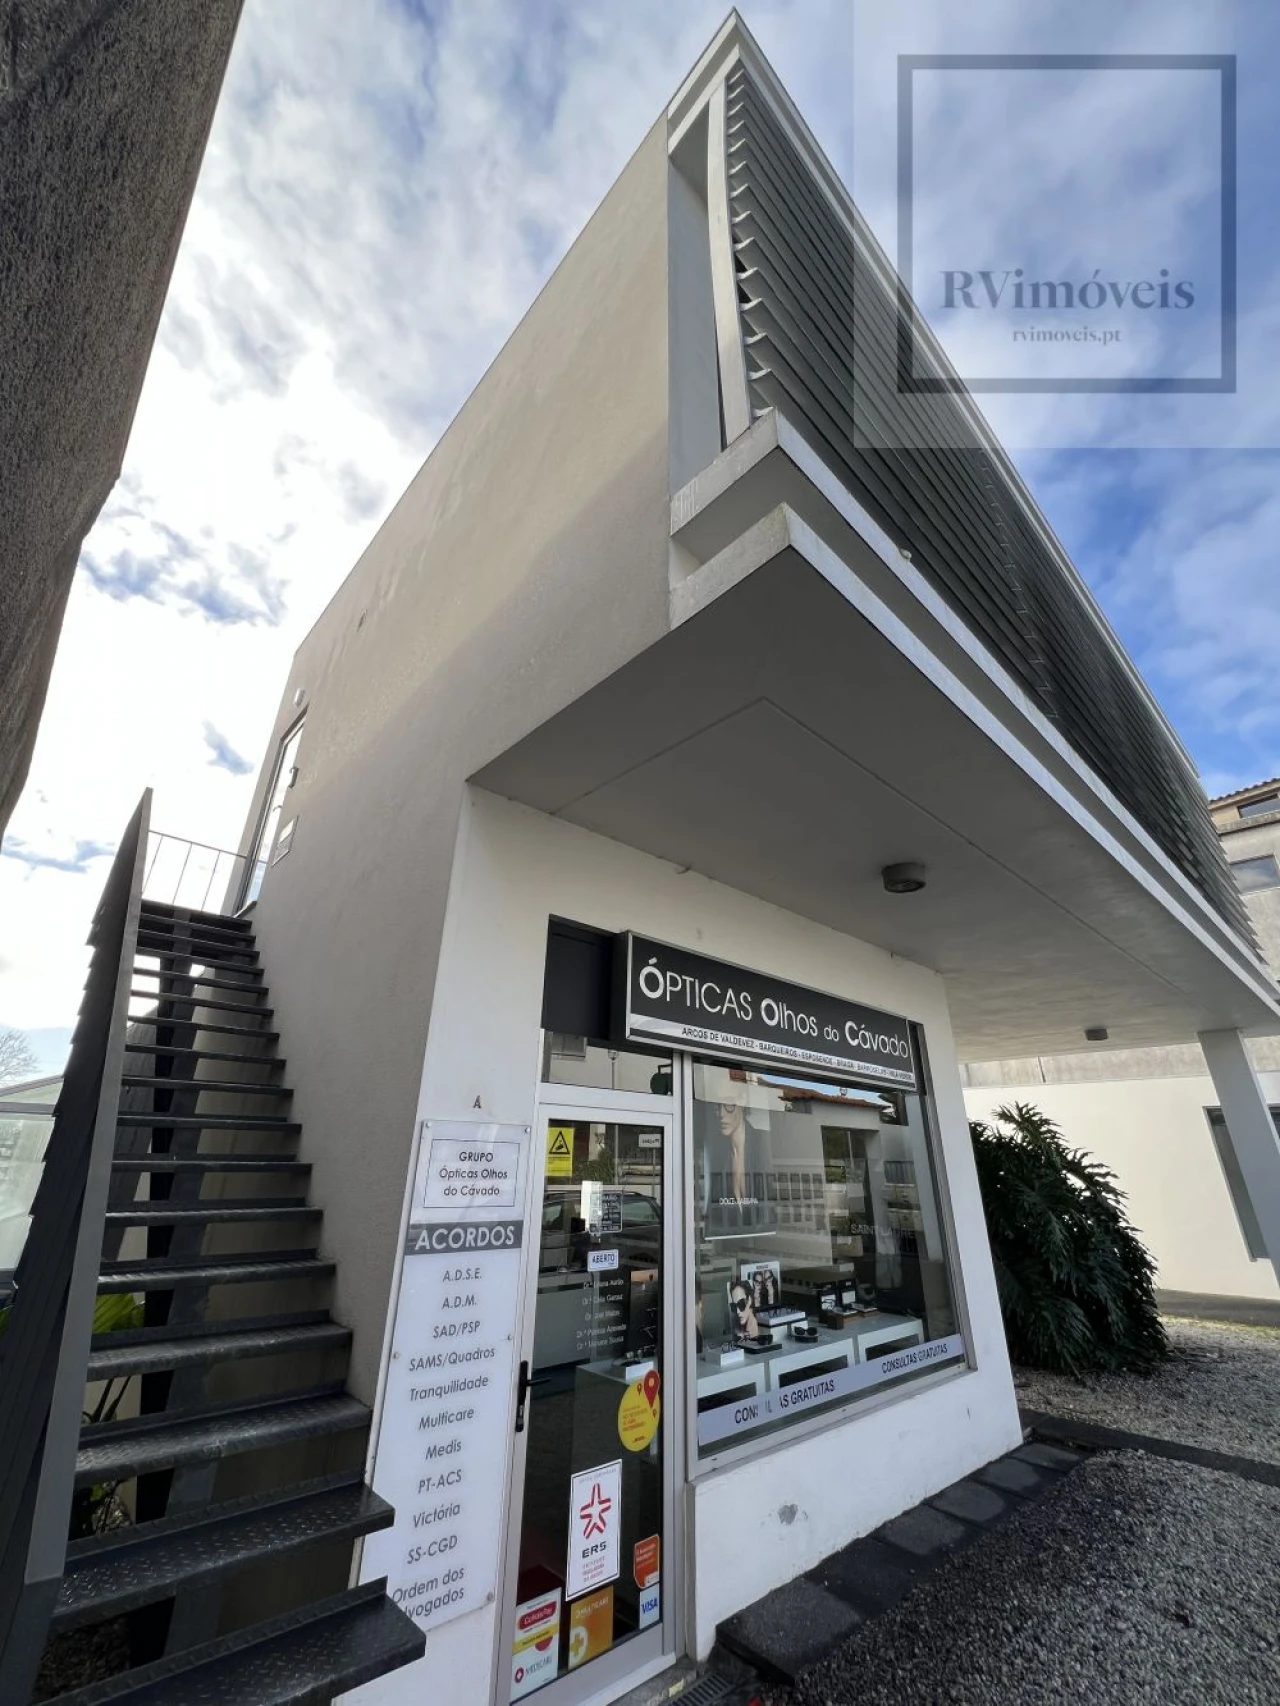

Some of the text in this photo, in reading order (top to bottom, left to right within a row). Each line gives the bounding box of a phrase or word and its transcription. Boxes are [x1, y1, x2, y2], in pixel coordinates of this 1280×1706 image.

[639, 957, 909, 1059] ÓPTICAS Olhos do Cávado
[682, 1027, 708, 1040] ARCOS
[710, 1032, 719, 1041] DE
[720, 1034, 755, 1049] VALDEVEZ
[459, 1151, 494, 1163] GRUPO
[439, 1165, 508, 1180] Ópticas Olhos
[443, 1185, 500, 1197] do Cávado
[415, 1225, 516, 1250] ACORDOS
[433, 1321, 481, 1339] SAD/PSP
[409, 1348, 496, 1372] SAMS/Quadros
[881, 1343, 948, 1374] CONSULTAS GRATUITAS
[409, 1375, 489, 1402] Tranquilidade
[790, 1379, 836, 1405] GRATUITAS
[418, 1408, 474, 1431] Multicare
[425, 1439, 462, 1461] Medis
[418, 1469, 462, 1494] PT-ACS
[413, 1502, 460, 1529] Victória
[407, 1535, 458, 1564] SS-CGD
[582, 1541, 607, 1559] ERS
[392, 1567, 464, 1603] Ordem dos
[641, 1596, 658, 1614] VISA
